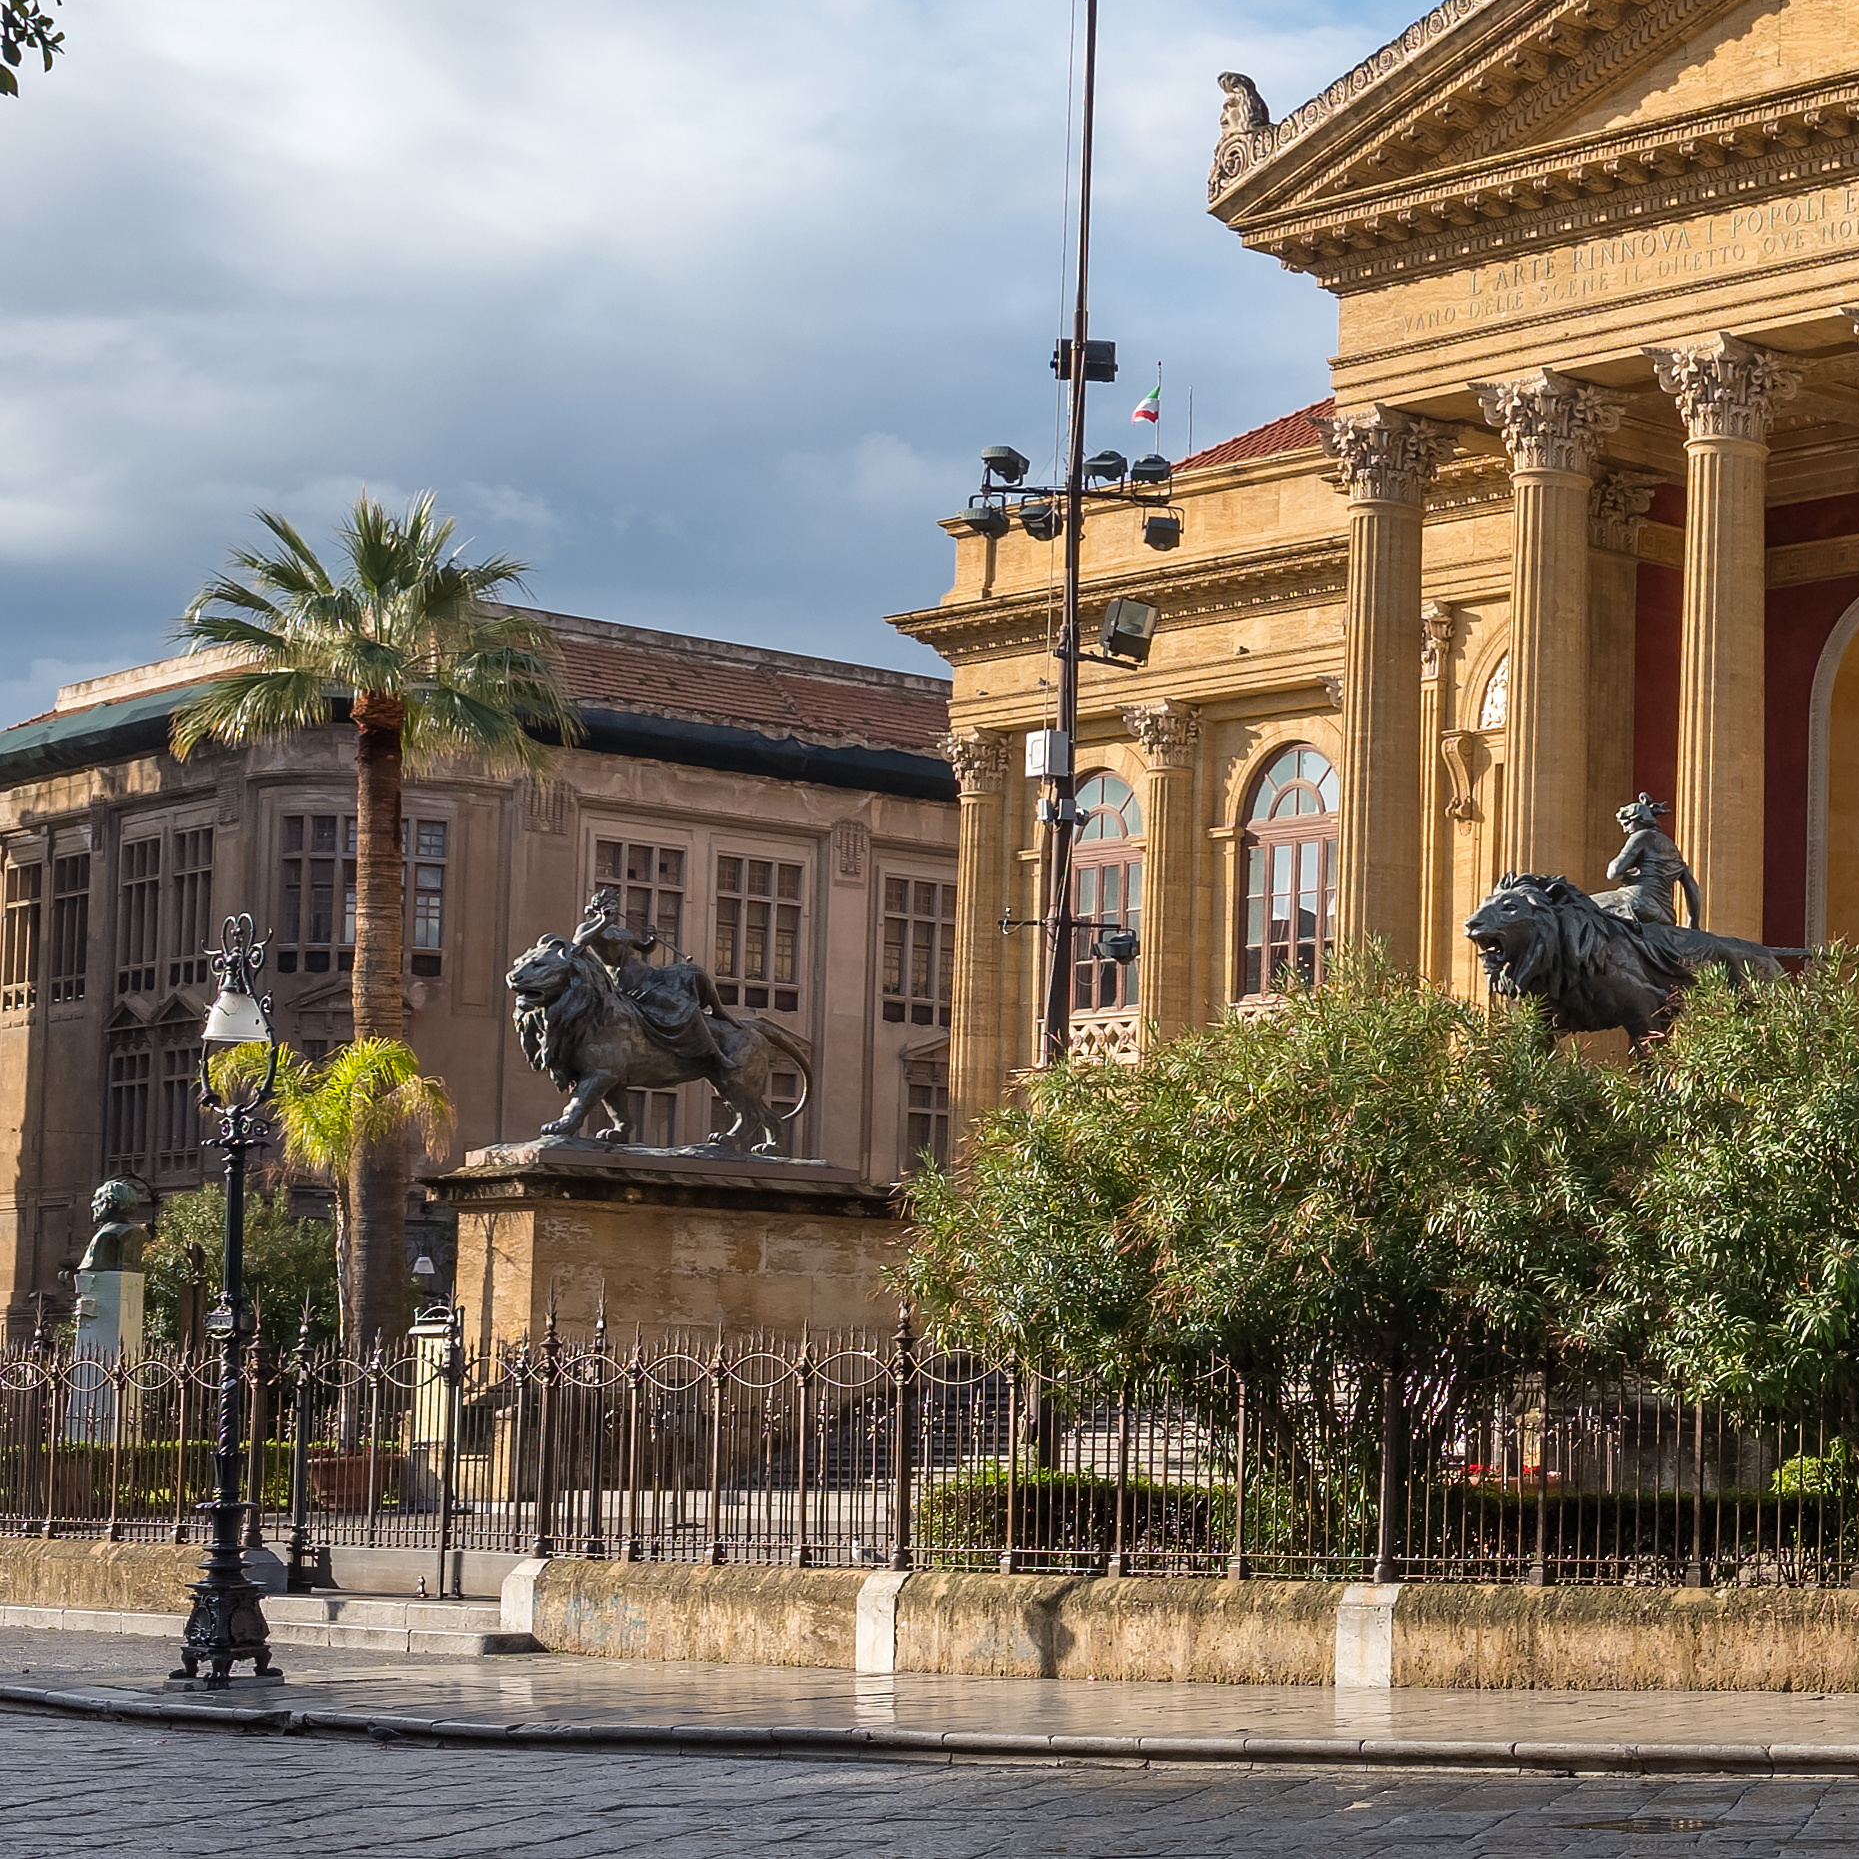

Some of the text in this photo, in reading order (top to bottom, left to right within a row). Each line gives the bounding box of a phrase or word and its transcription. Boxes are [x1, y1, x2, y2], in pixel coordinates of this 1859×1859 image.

[1401, 306, 1456, 334] VANO
[1469, 291, 1524, 319] DELLE
[1539, 272, 1609, 304] SCENE
[1623, 265, 1643, 286] IL
[1658, 244, 1745, 277] DILETTO
[1763, 229, 1805, 254] OVE
[1470, 254, 1556, 296] L'ARTE
[1572, 227, 1692, 273] RINNOVA
[1706, 220, 1714, 244] I
[1730, 194, 1827, 238] POPOLI
[1843, 188, 1857, 214] E
